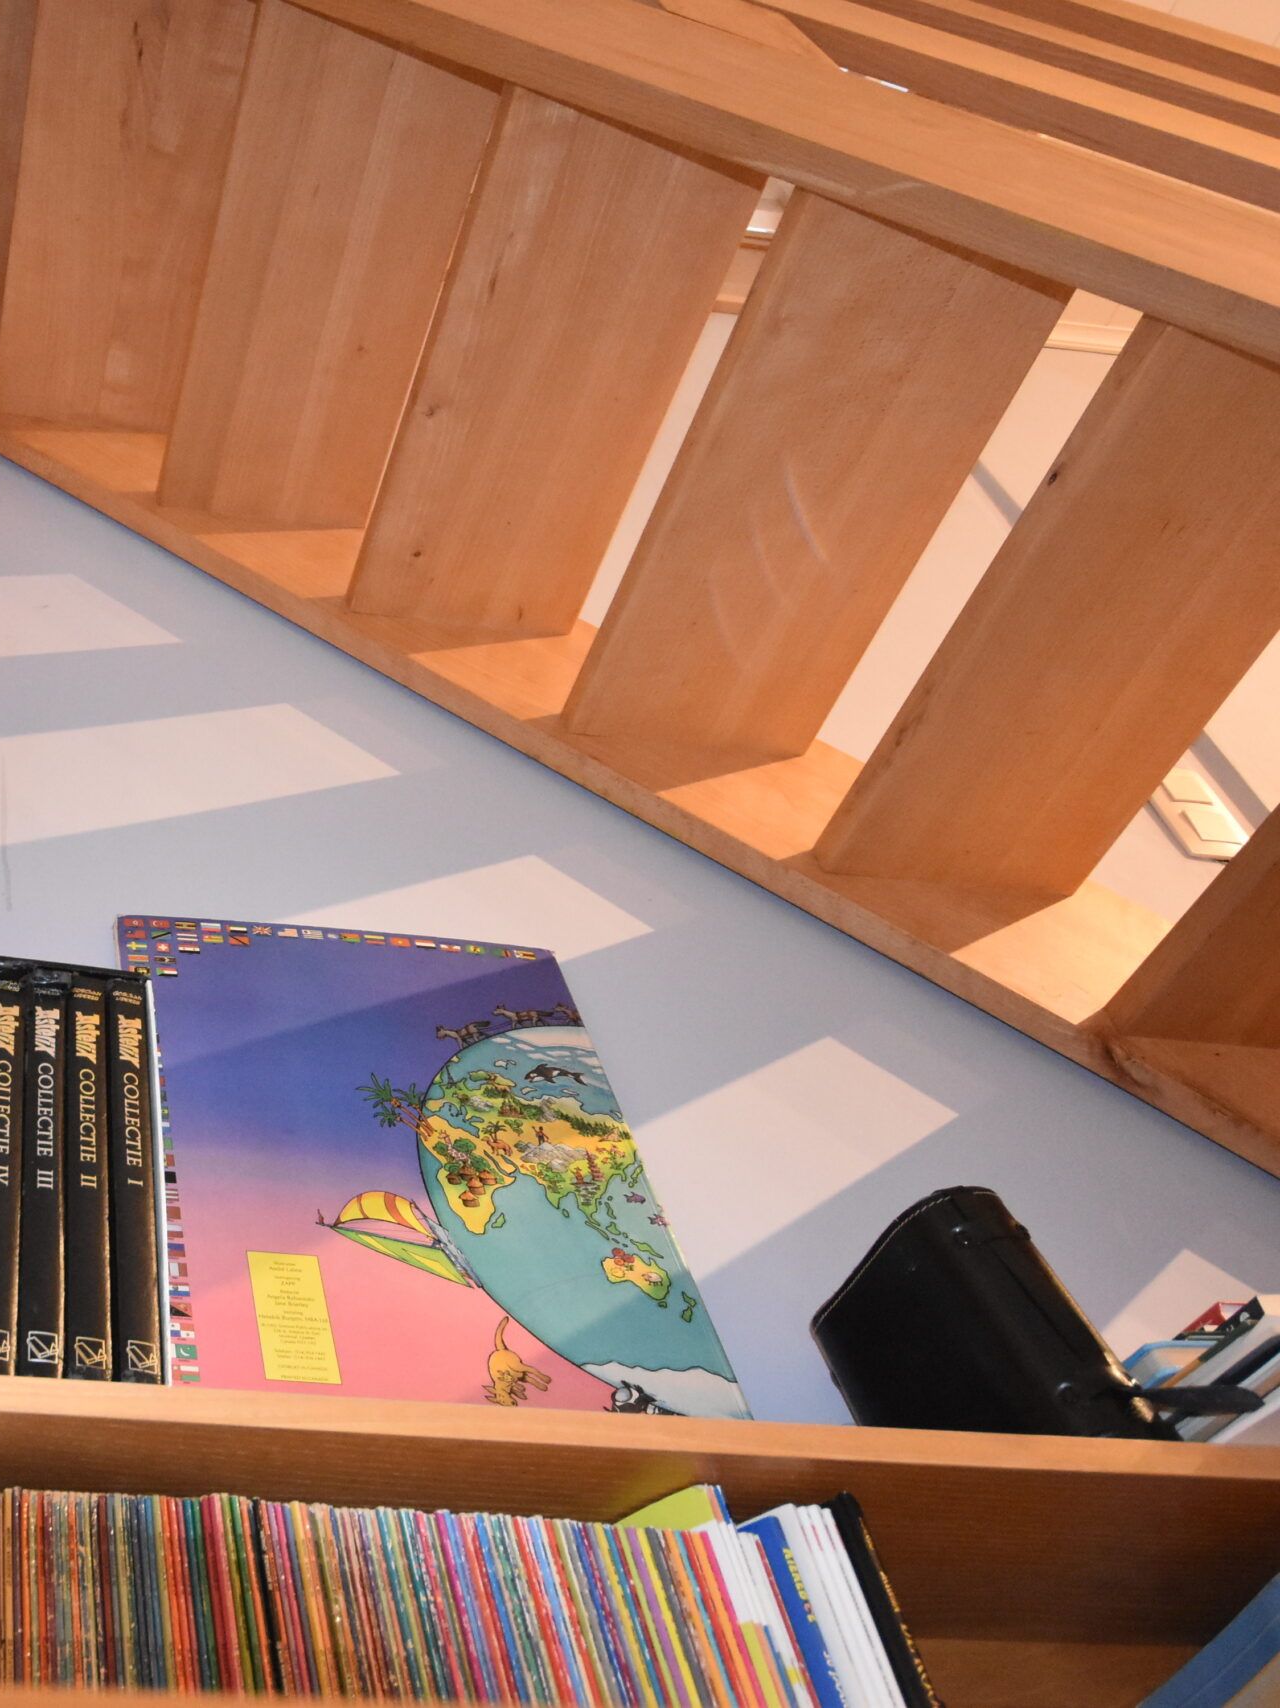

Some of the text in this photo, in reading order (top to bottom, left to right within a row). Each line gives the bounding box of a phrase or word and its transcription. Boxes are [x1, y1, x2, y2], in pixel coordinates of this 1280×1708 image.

[34, 1005, 61, 1059] Asterix
[36, 1062, 55, 1158] COLLECTIE
[75, 1010, 101, 1189] Asterix COLLECTIE II
[118, 1014, 145, 1188] Asterix COLLECTIE I
[36, 1168, 55, 1190] III
